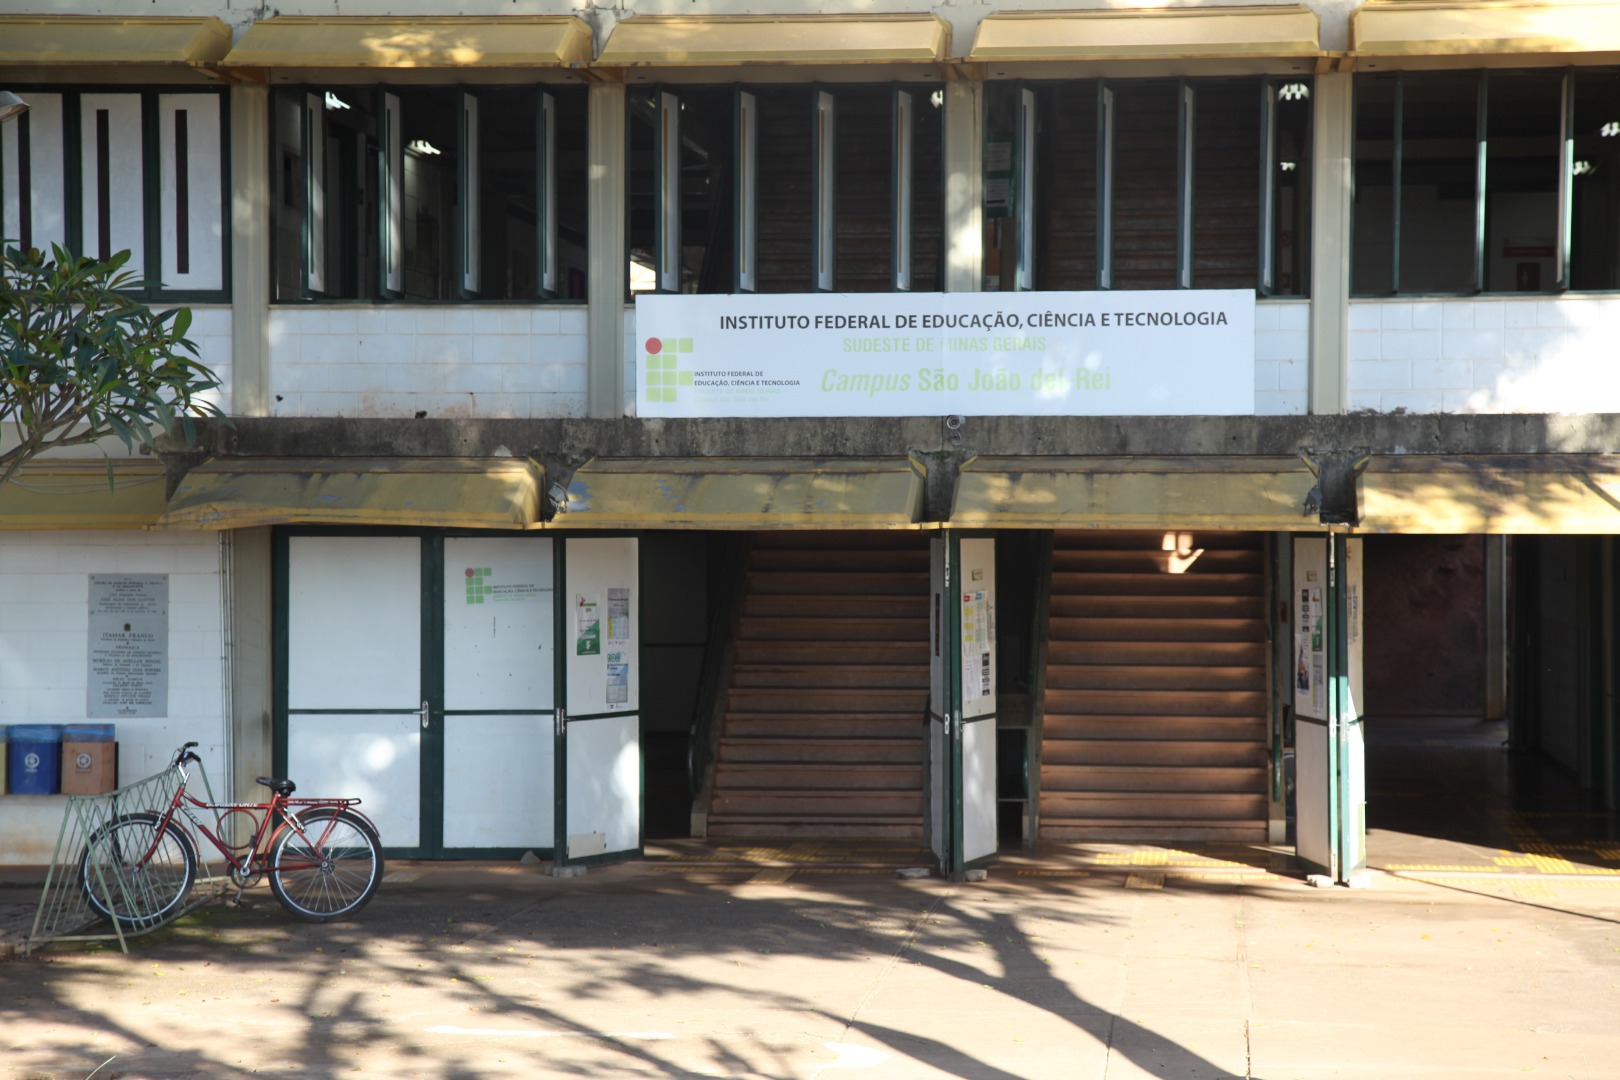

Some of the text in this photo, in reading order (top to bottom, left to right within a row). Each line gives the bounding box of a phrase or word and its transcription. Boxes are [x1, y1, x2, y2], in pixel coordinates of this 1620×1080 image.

[720, 310, 1229, 332] INSTITUTO FEDERAL DE EDUCAÇÃO, CIÊNCIA E TECNOLOGIA
[842, 336, 911, 353] SUDESTE
[915, 336, 935, 352] DE
[992, 335, 1047, 352] GERAIS
[820, 367, 913, 398] Campus
[917, 367, 959, 392] São
[967, 367, 1023, 392] João
